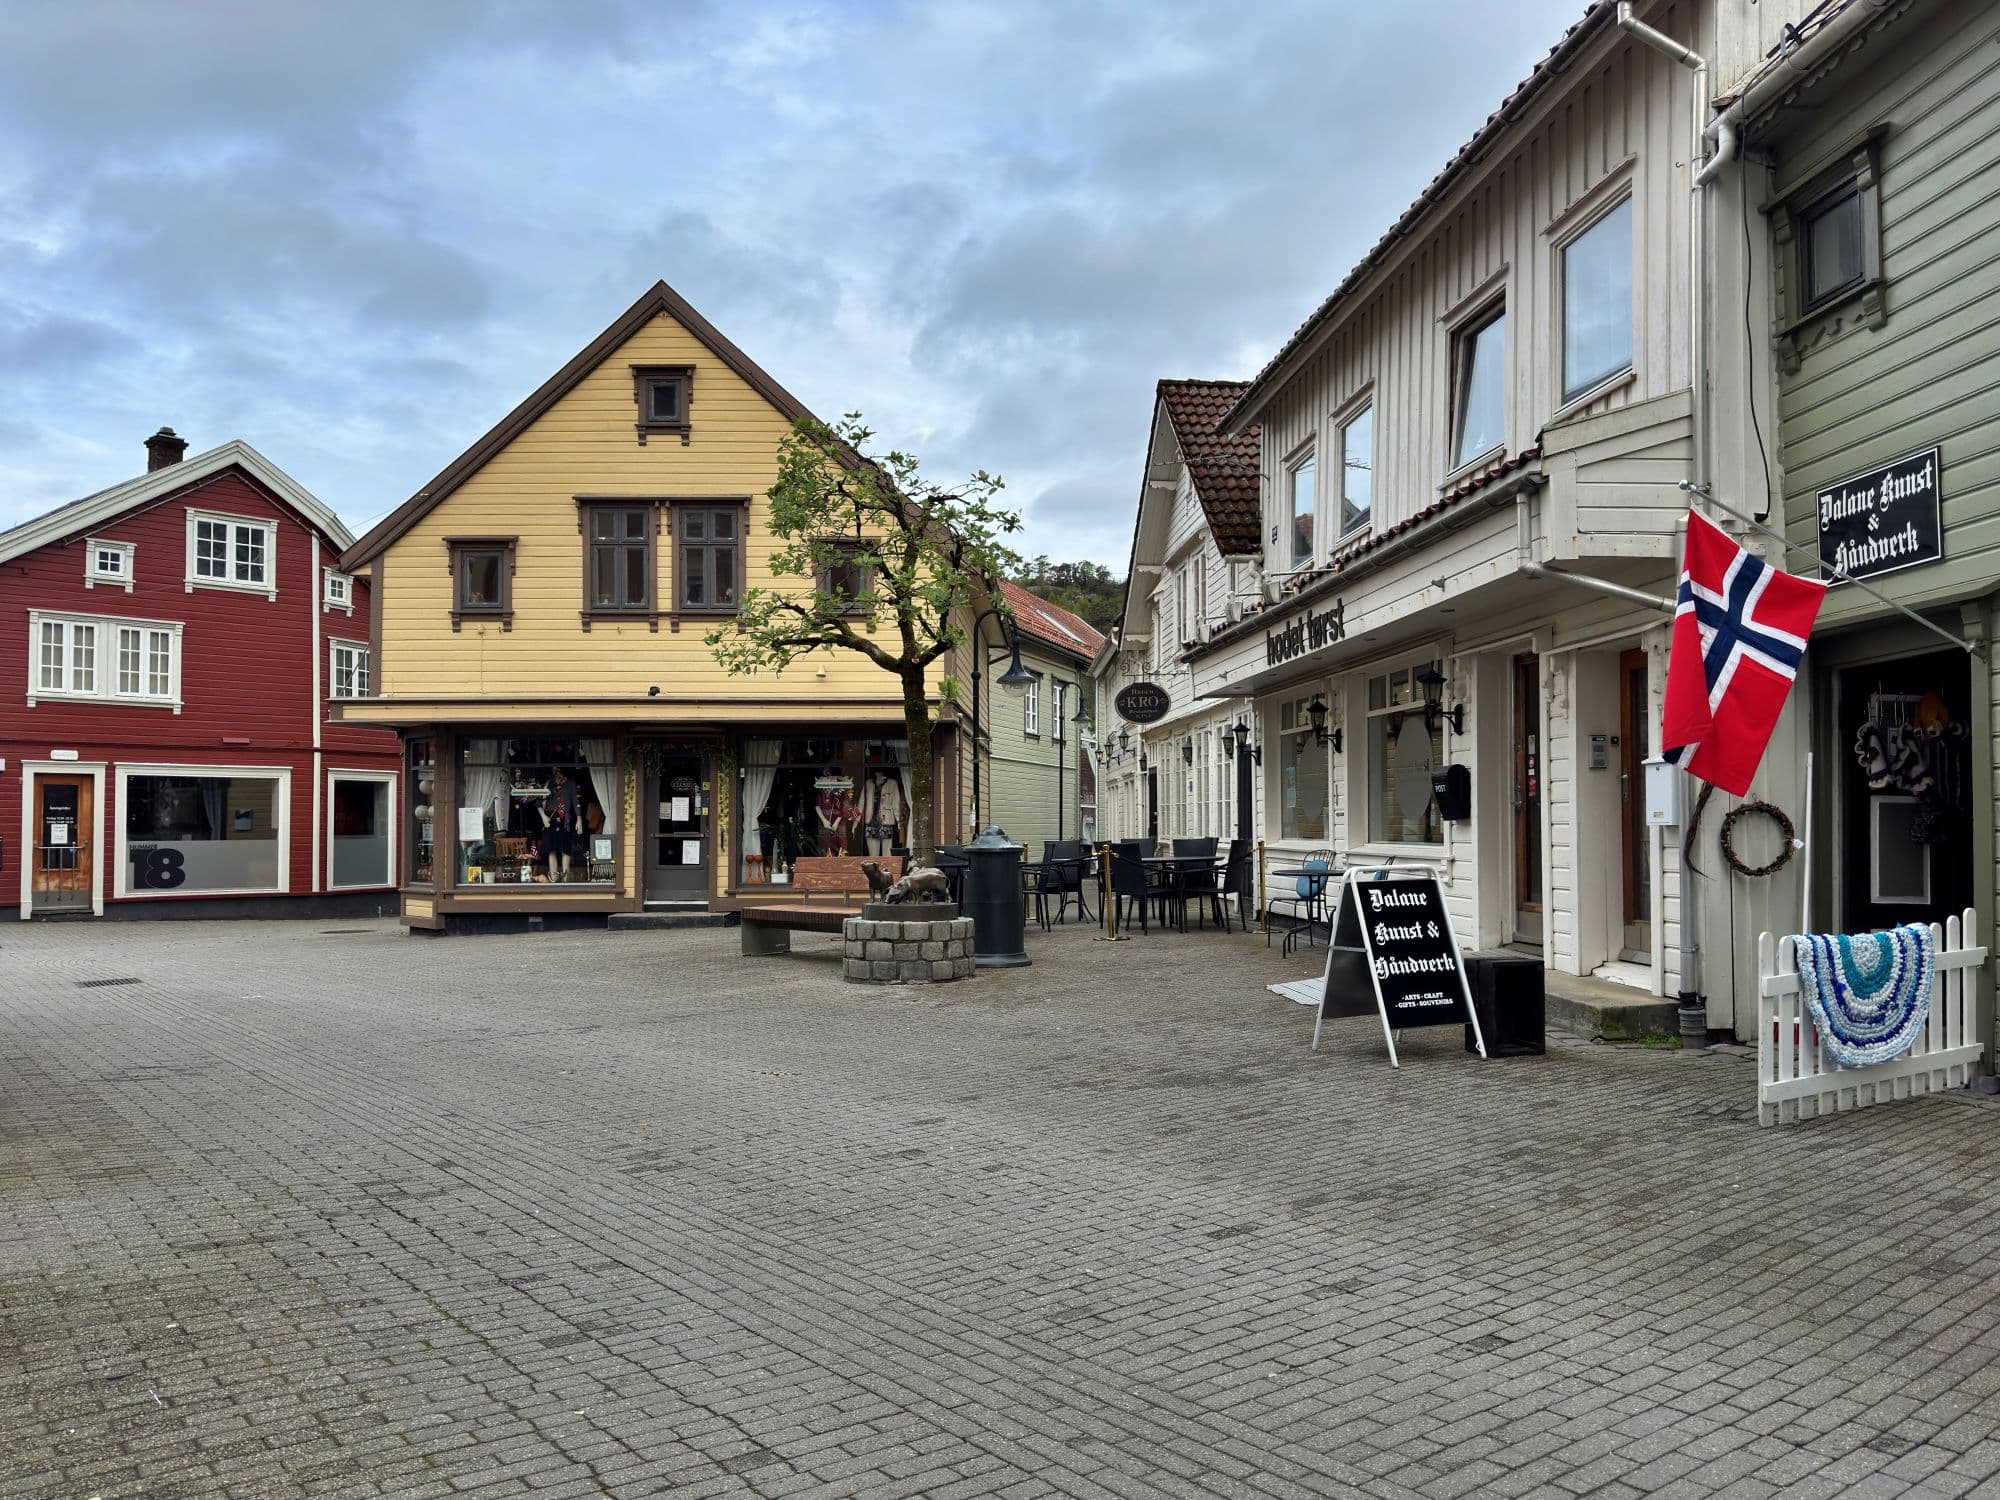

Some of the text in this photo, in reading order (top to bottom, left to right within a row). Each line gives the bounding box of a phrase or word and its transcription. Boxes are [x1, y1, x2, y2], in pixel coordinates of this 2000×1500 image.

[1820, 459, 1933, 531] Dalane Kunst
[1866, 513, 1880, 532] &
[1834, 521, 1919, 575] Håndverk
[1266, 597, 1346, 666] hodet først
[1126, 696, 1159, 708] KRO
[1435, 784, 1446, 793] POST
[129, 848, 186, 889] 18
[1368, 888, 1428, 912] Dalane
[1374, 920, 1440, 946] Kunst &
[1375, 952, 1456, 980] Håndverk
